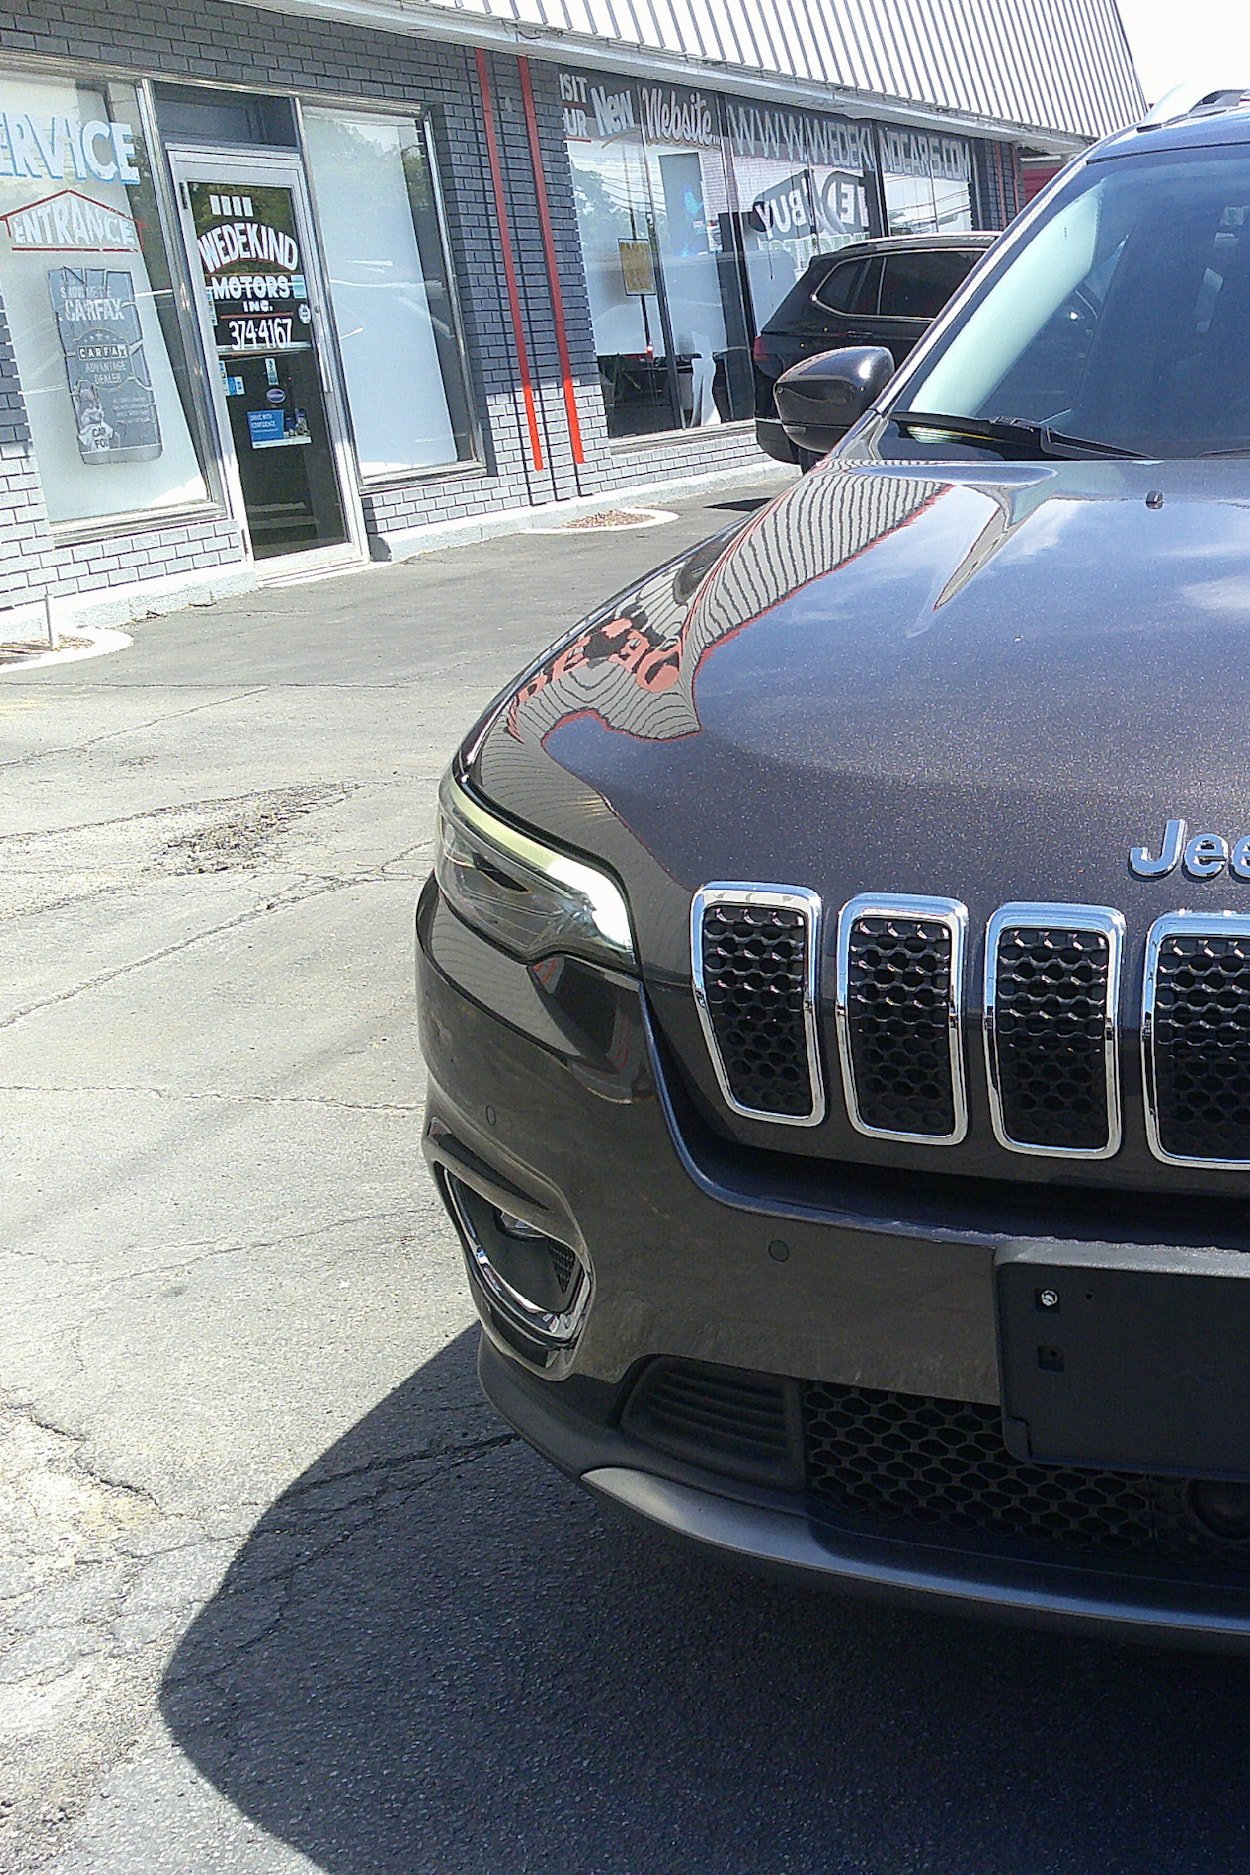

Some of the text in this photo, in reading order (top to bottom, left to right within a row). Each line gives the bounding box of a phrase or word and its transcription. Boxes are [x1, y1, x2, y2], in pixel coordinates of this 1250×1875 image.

[563, 107, 588, 137] UR
[590, 86, 635, 137] New
[12, 197, 136, 246] ENTRANCE
[198, 222, 299, 273] WEDEKIND
[211, 276, 291, 299] MOTORS
[64, 298, 125, 321] CARFAX
[243, 301, 273, 313] INC.
[78, 344, 129, 359] CARFAX
